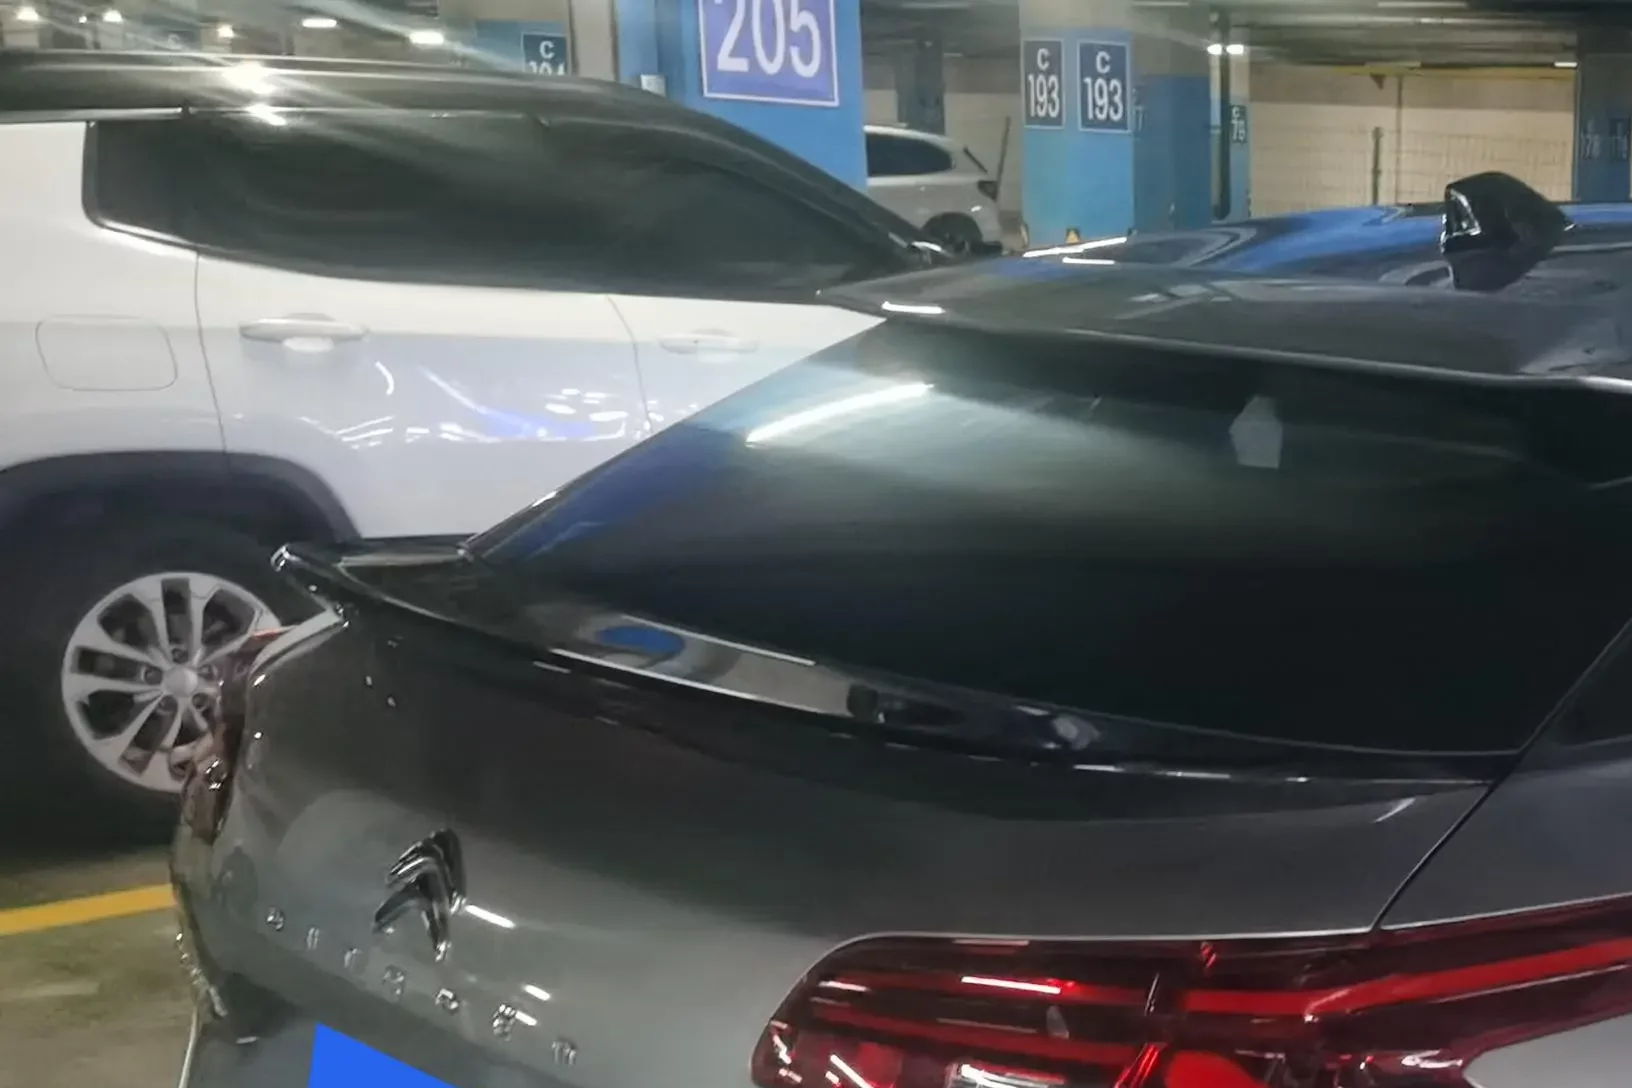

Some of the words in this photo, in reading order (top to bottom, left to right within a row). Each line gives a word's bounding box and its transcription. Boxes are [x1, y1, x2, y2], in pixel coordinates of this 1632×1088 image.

[539, 40, 555, 60] C
[717, 0, 821, 78] 205
[1037, 48, 1050, 70] C
[1095, 51, 1111, 74] C
[1028, 74, 1060, 118] 193
[1083, 77, 1123, 121] 193
